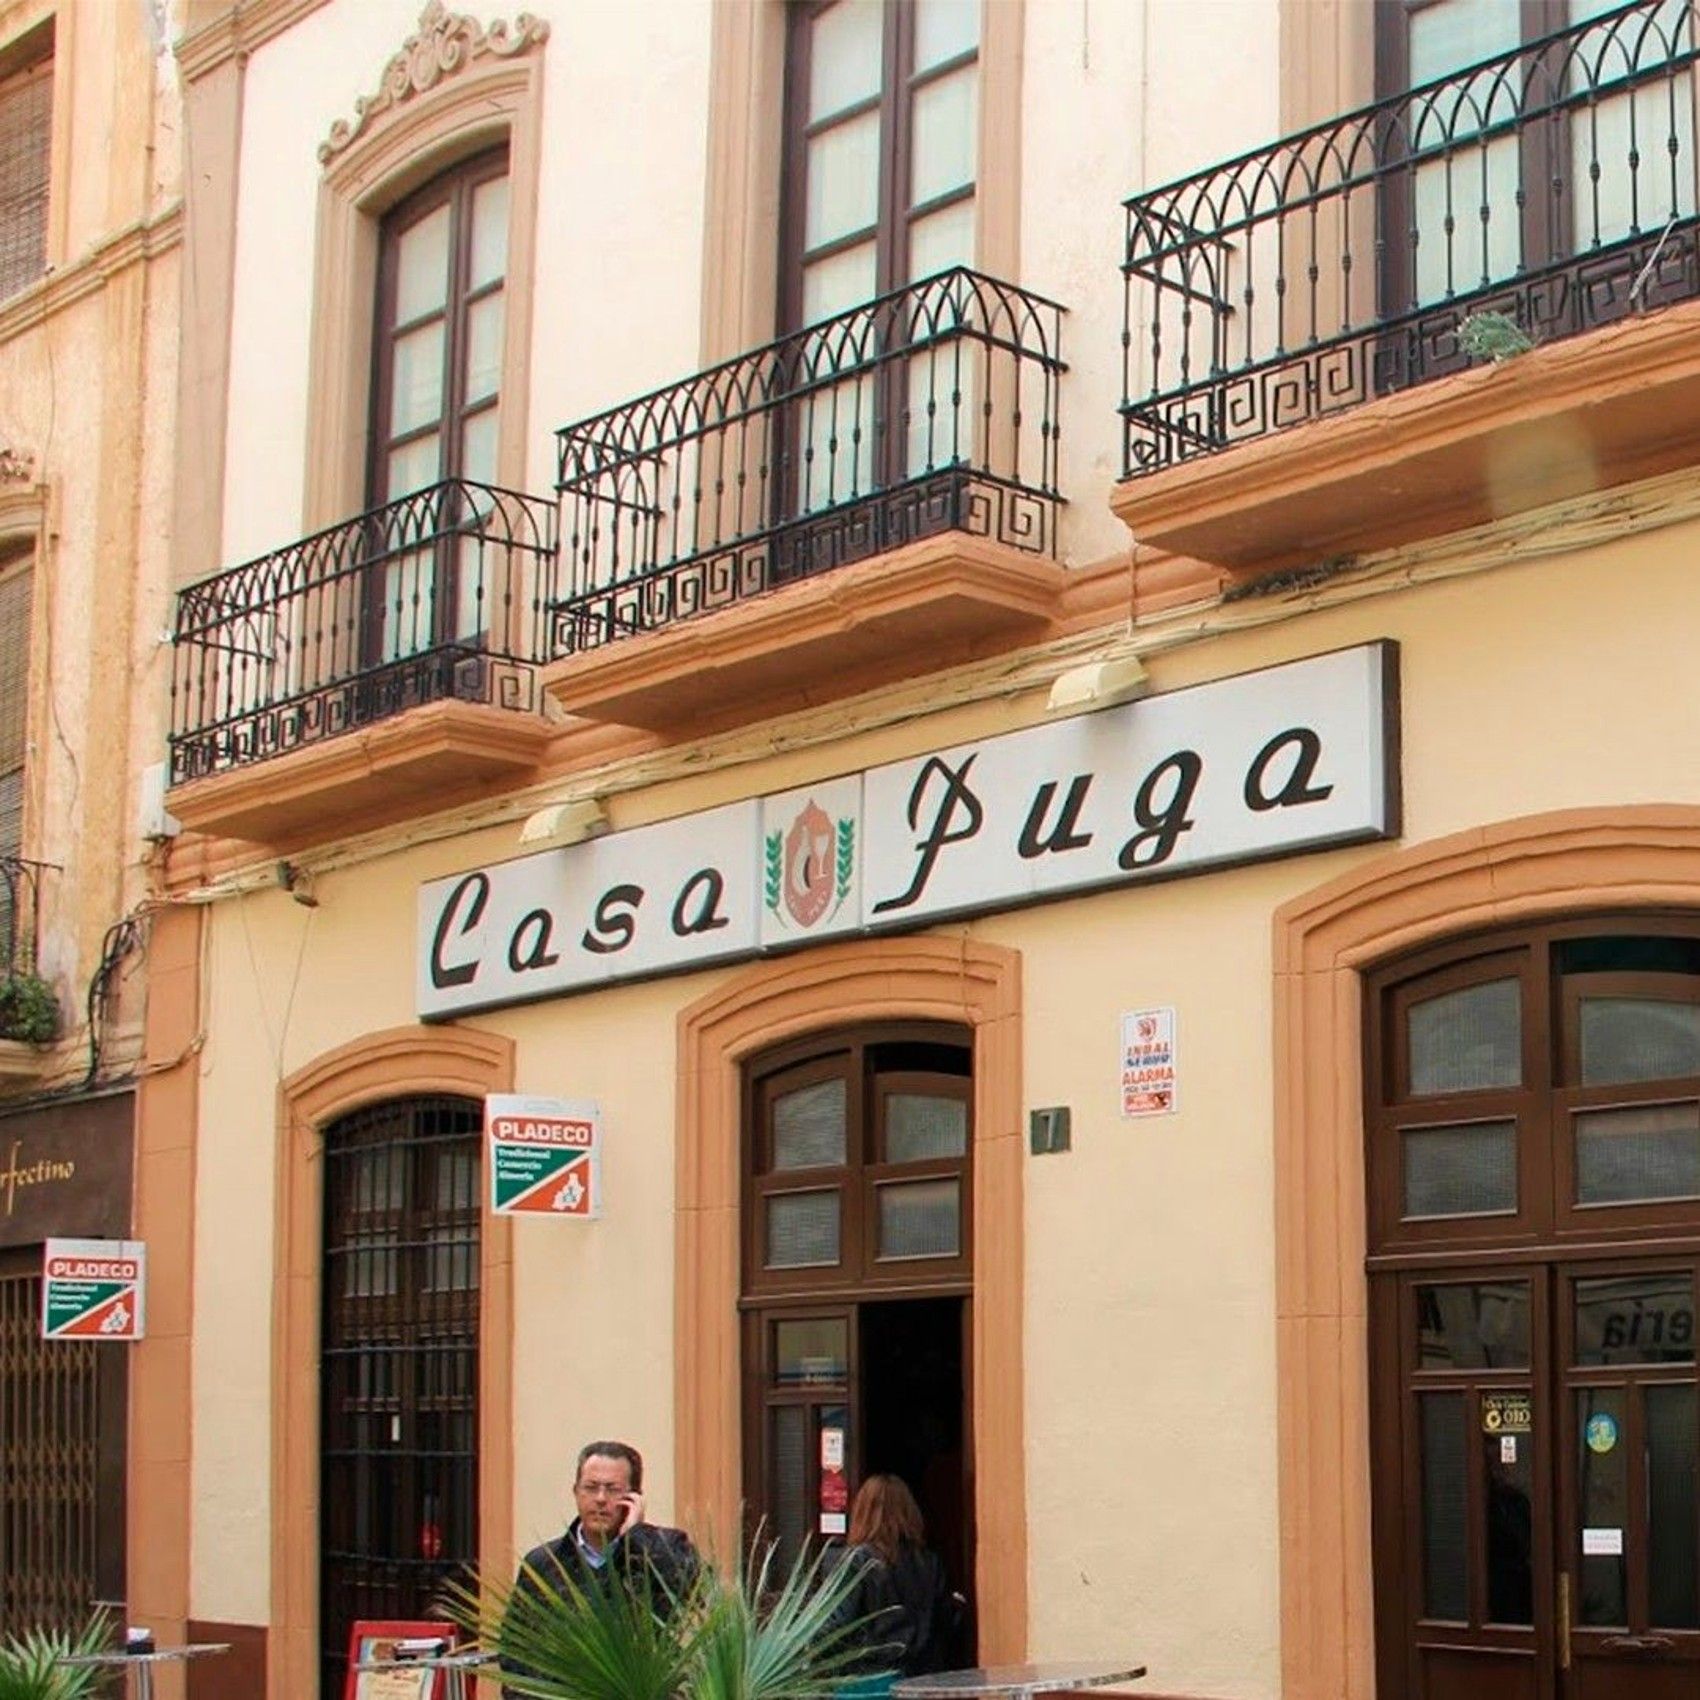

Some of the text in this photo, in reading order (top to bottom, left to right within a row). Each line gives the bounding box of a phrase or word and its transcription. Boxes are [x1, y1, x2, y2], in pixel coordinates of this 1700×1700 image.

[430, 725, 1334, 989] Casa Puga
[1123, 1067, 1174, 1085] ALARMA
[498, 1121, 589, 1143] PLADECO
[52, 1262, 135, 1278] PLADECO
